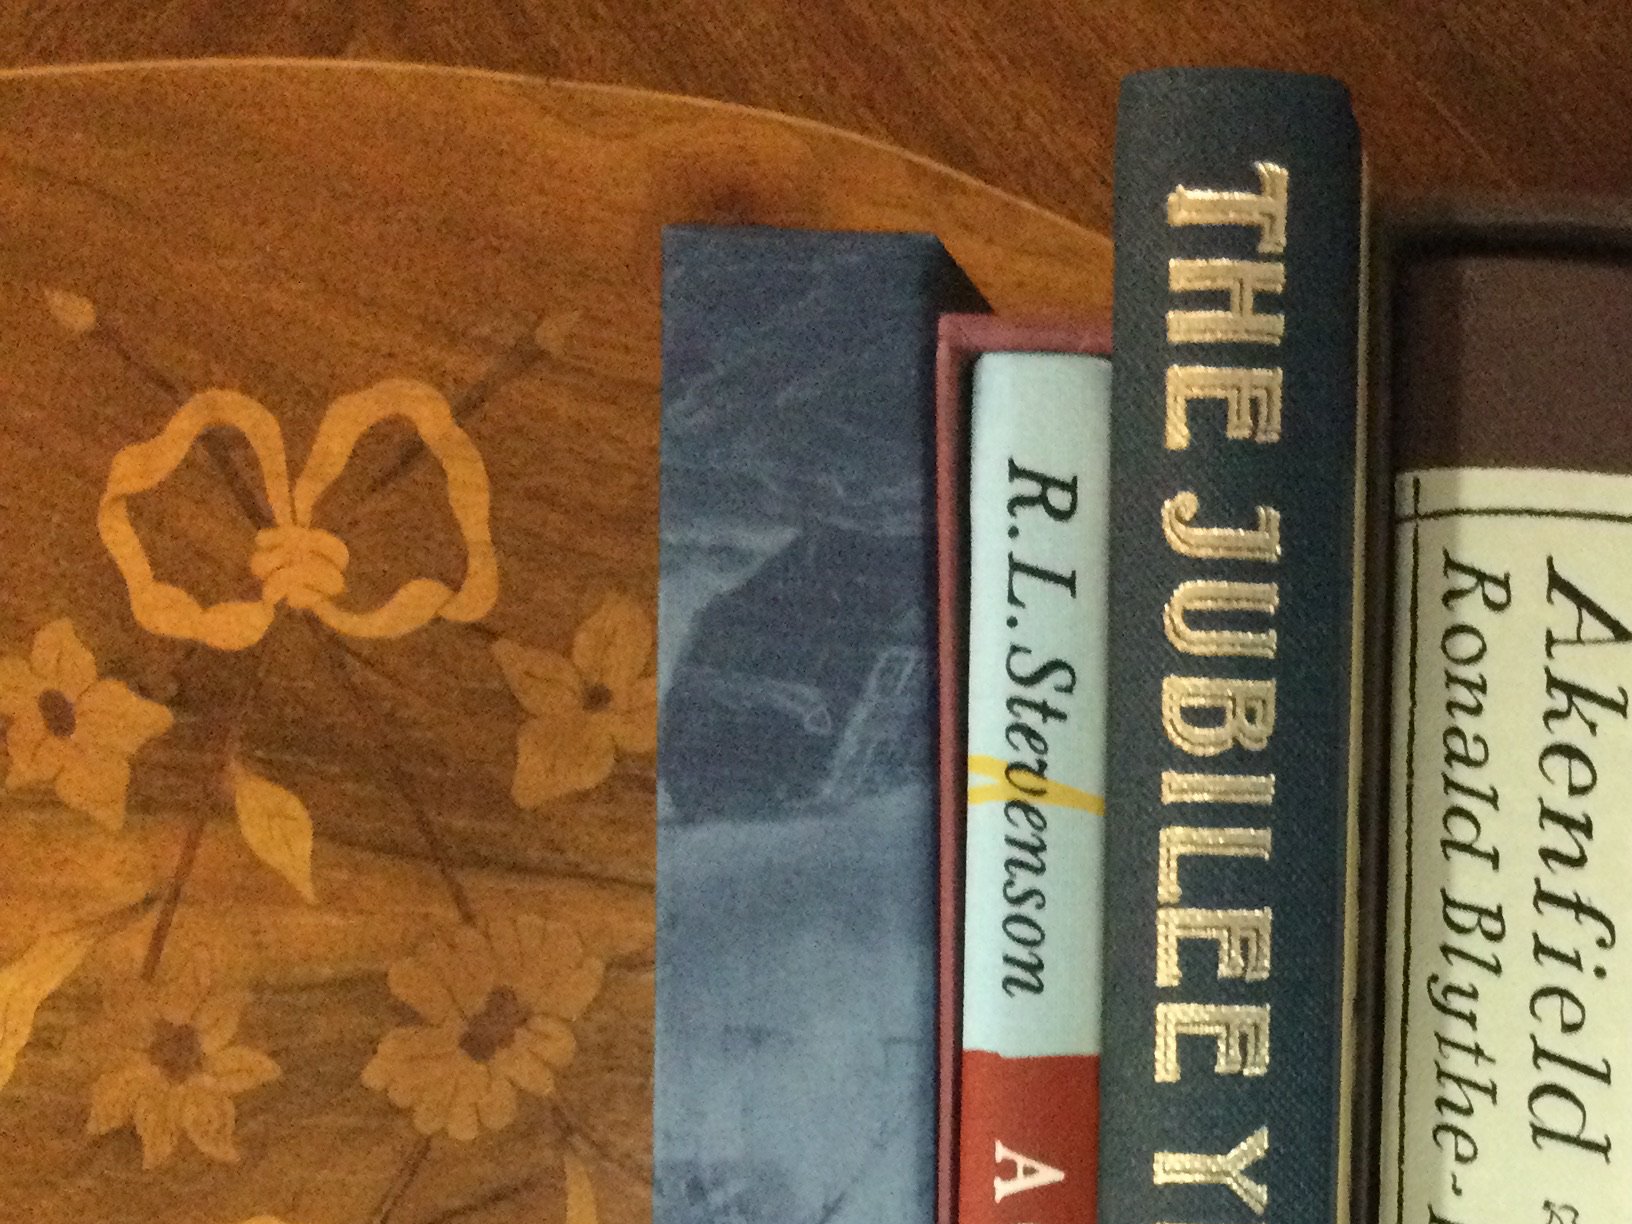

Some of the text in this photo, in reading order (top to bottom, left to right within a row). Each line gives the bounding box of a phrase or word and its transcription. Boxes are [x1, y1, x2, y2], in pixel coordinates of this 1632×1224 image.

[1165, 161, 1289, 450] THE
[1154, 491, 1282, 1083] JUBILEE
[1441, 548, 1512, 871] Ronald
[993, 1139, 1066, 1204] A
